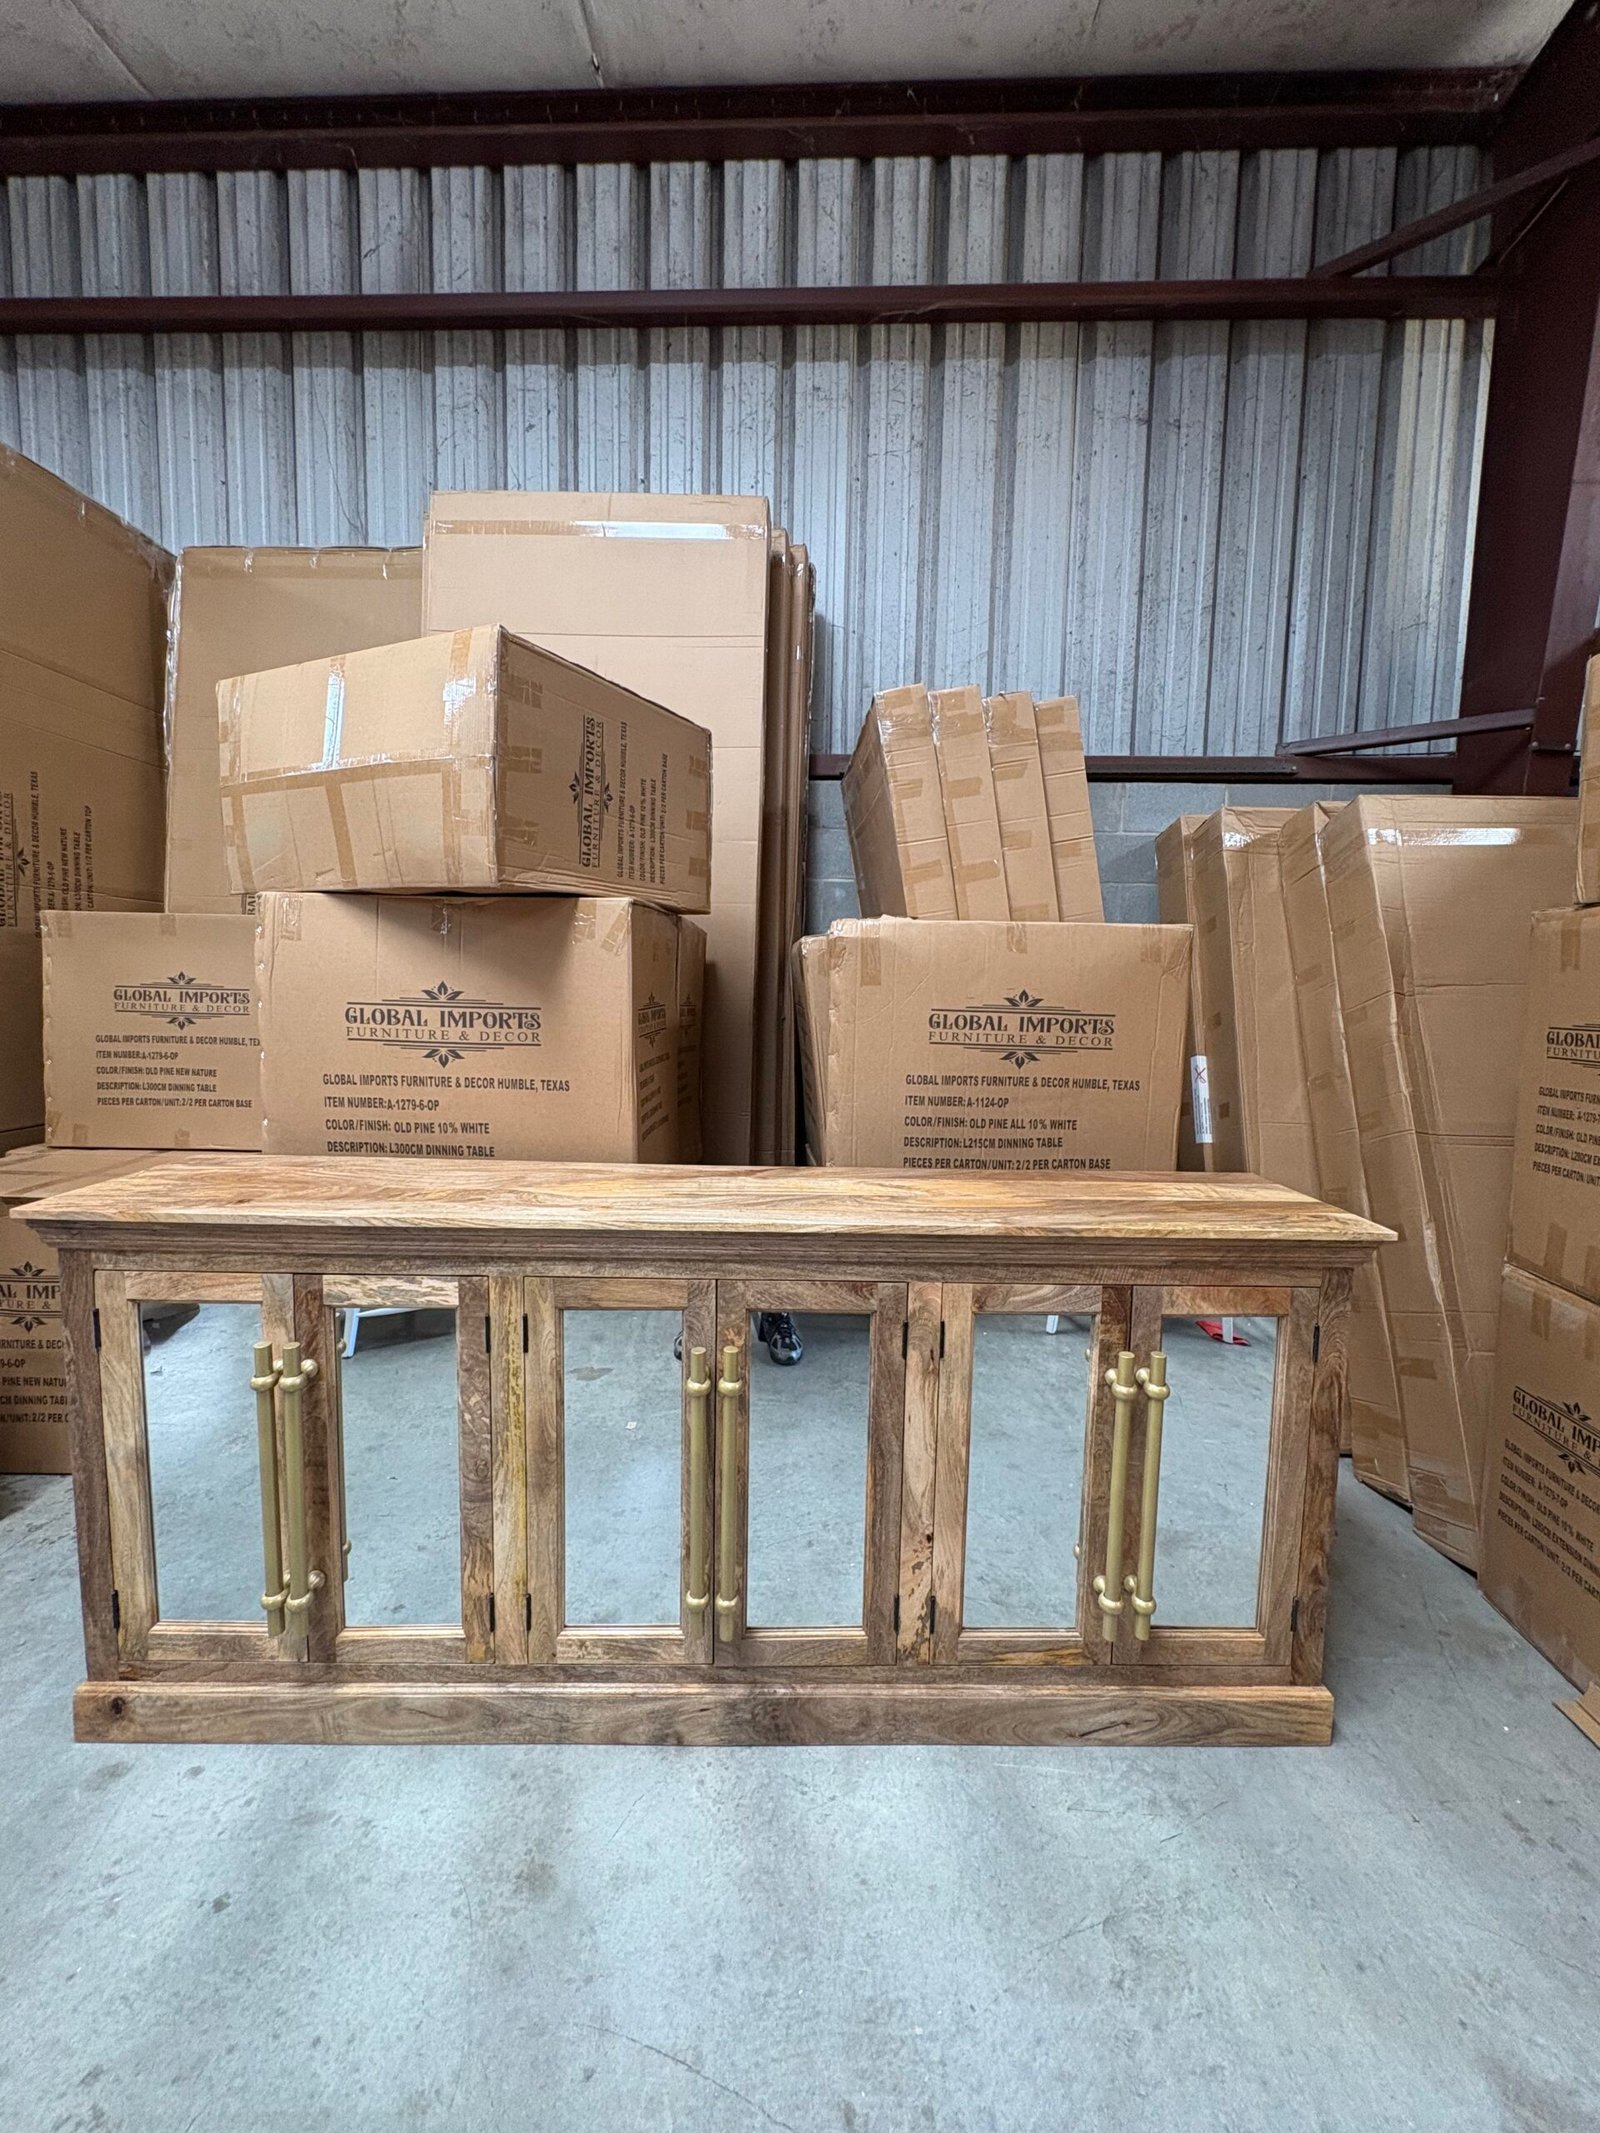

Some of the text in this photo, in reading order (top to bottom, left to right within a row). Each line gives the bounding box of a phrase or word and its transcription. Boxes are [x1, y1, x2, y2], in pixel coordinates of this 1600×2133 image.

[620, 721, 628, 740] TEXAS
[594, 774, 601, 783] &
[582, 717, 595, 867] GLOBAL IMPORTS
[592, 788, 600, 867] FURNITURE
[6, 856, 15, 927] FURNITURE
[113, 989, 249, 1004] GLOBAL IMPORTS
[114, 1003, 185, 1011] FURNITURE
[206, 1004, 249, 1012] DECOR
[344, 1006, 541, 1030] GLOBAL IMPORTS
[928, 1013, 1114, 1034] GLOBAL IMPORTS
[95, 1034, 120, 1043] GLOBAL
[122, 1035, 150, 1044] IMPORTS
[151, 1035, 187, 1044] FURNITURE
[189, 1036, 193, 1045] &
[195, 1036, 217, 1045] DECOR
[249, 1037, 260, 1046] TEX
[346, 1026, 540, 1042] FURNITURE & DECOR
[928, 1031, 1112, 1046] FURNITURE & DECOR
[95, 1050, 111, 1058] ITEM
[1546, 1047, 1600, 1059] FURNITU
[146, 1067, 158, 1075] OLD
[159, 1068, 174, 1076] PINE
[175, 1068, 189, 1076] NEW
[191, 1068, 216, 1077] NATURE
[168, 1083, 194, 1092] DINNING
[196, 1084, 216, 1092] TABLE
[323, 1074, 569, 1092] GLOBAL IMPORTS FURNITURE & DECOR HUMBLE, TEXAS
[905, 1074, 1140, 1091] GLOBAL IMPORTS FURNITURE & DECOR HUMBLE, TEXAS
[1538, 1086, 1558, 1098] GLOBAL
[1560, 1089, 1583, 1101] IMPORTS
[97, 1097, 119, 1106] PIECES
[121, 1098, 133, 1106] PER
[194, 1099, 206, 1107] PER
[208, 1099, 234, 1108] CARTON
[236, 1100, 252, 1108] BASE
[324, 1096, 344, 1108] ITEM
[904, 1095, 924, 1106] ITEM
[325, 1119, 489, 1133] COLOR/FINISH: OLD PINE 10% WHITE
[904, 1116, 1077, 1130] COLOR/FINISH: OLD PINE ALL 10% WHITE
[327, 1141, 387, 1154] DESCRIPTION:
[426, 1144, 463, 1156] DINNING
[467, 1145, 495, 1157] TABLE
[997, 1137, 1033, 1148] DINNING
[1035, 1137, 1062, 1148] TABLE
[903, 1157, 932, 1169] PIECES
[935, 1157, 950, 1169] PER
[1033, 1157, 1049, 1169] PER
[1051, 1158, 1085, 1170] CARTON
[1089, 1158, 1110, 1170] BASE
[42, 1301, 51, 1310] &
[0, 1339, 36, 1349] RNITURE
[2, 1376, 67, 1387] PINE NEW NATU
[49, 1395, 68, 1405] TAB
[1513, 1388, 1564, 1432] GLOBAL
[1584, 1448, 1591, 1461] &
